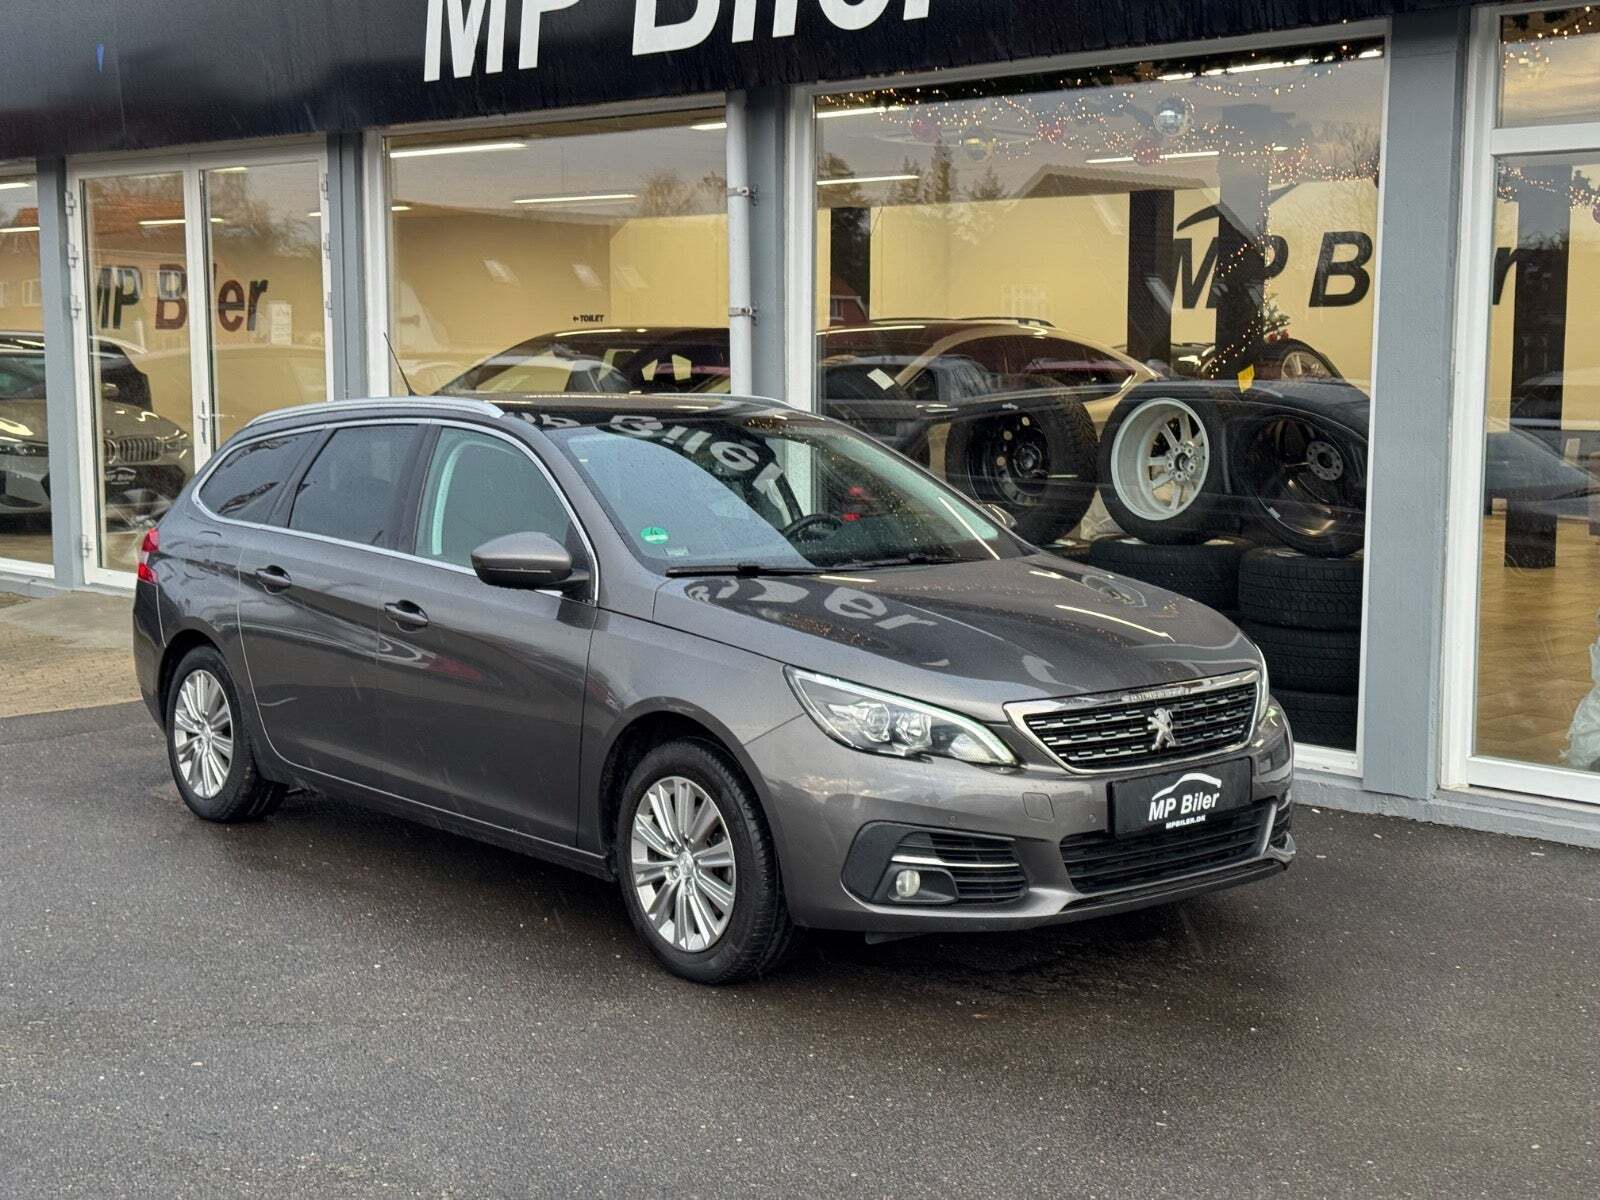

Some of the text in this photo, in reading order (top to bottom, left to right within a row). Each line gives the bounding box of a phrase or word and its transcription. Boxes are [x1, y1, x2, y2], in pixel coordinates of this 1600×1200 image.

[579, 314, 604, 323] TOILET
[1148, 791, 1220, 821] MP Biler
